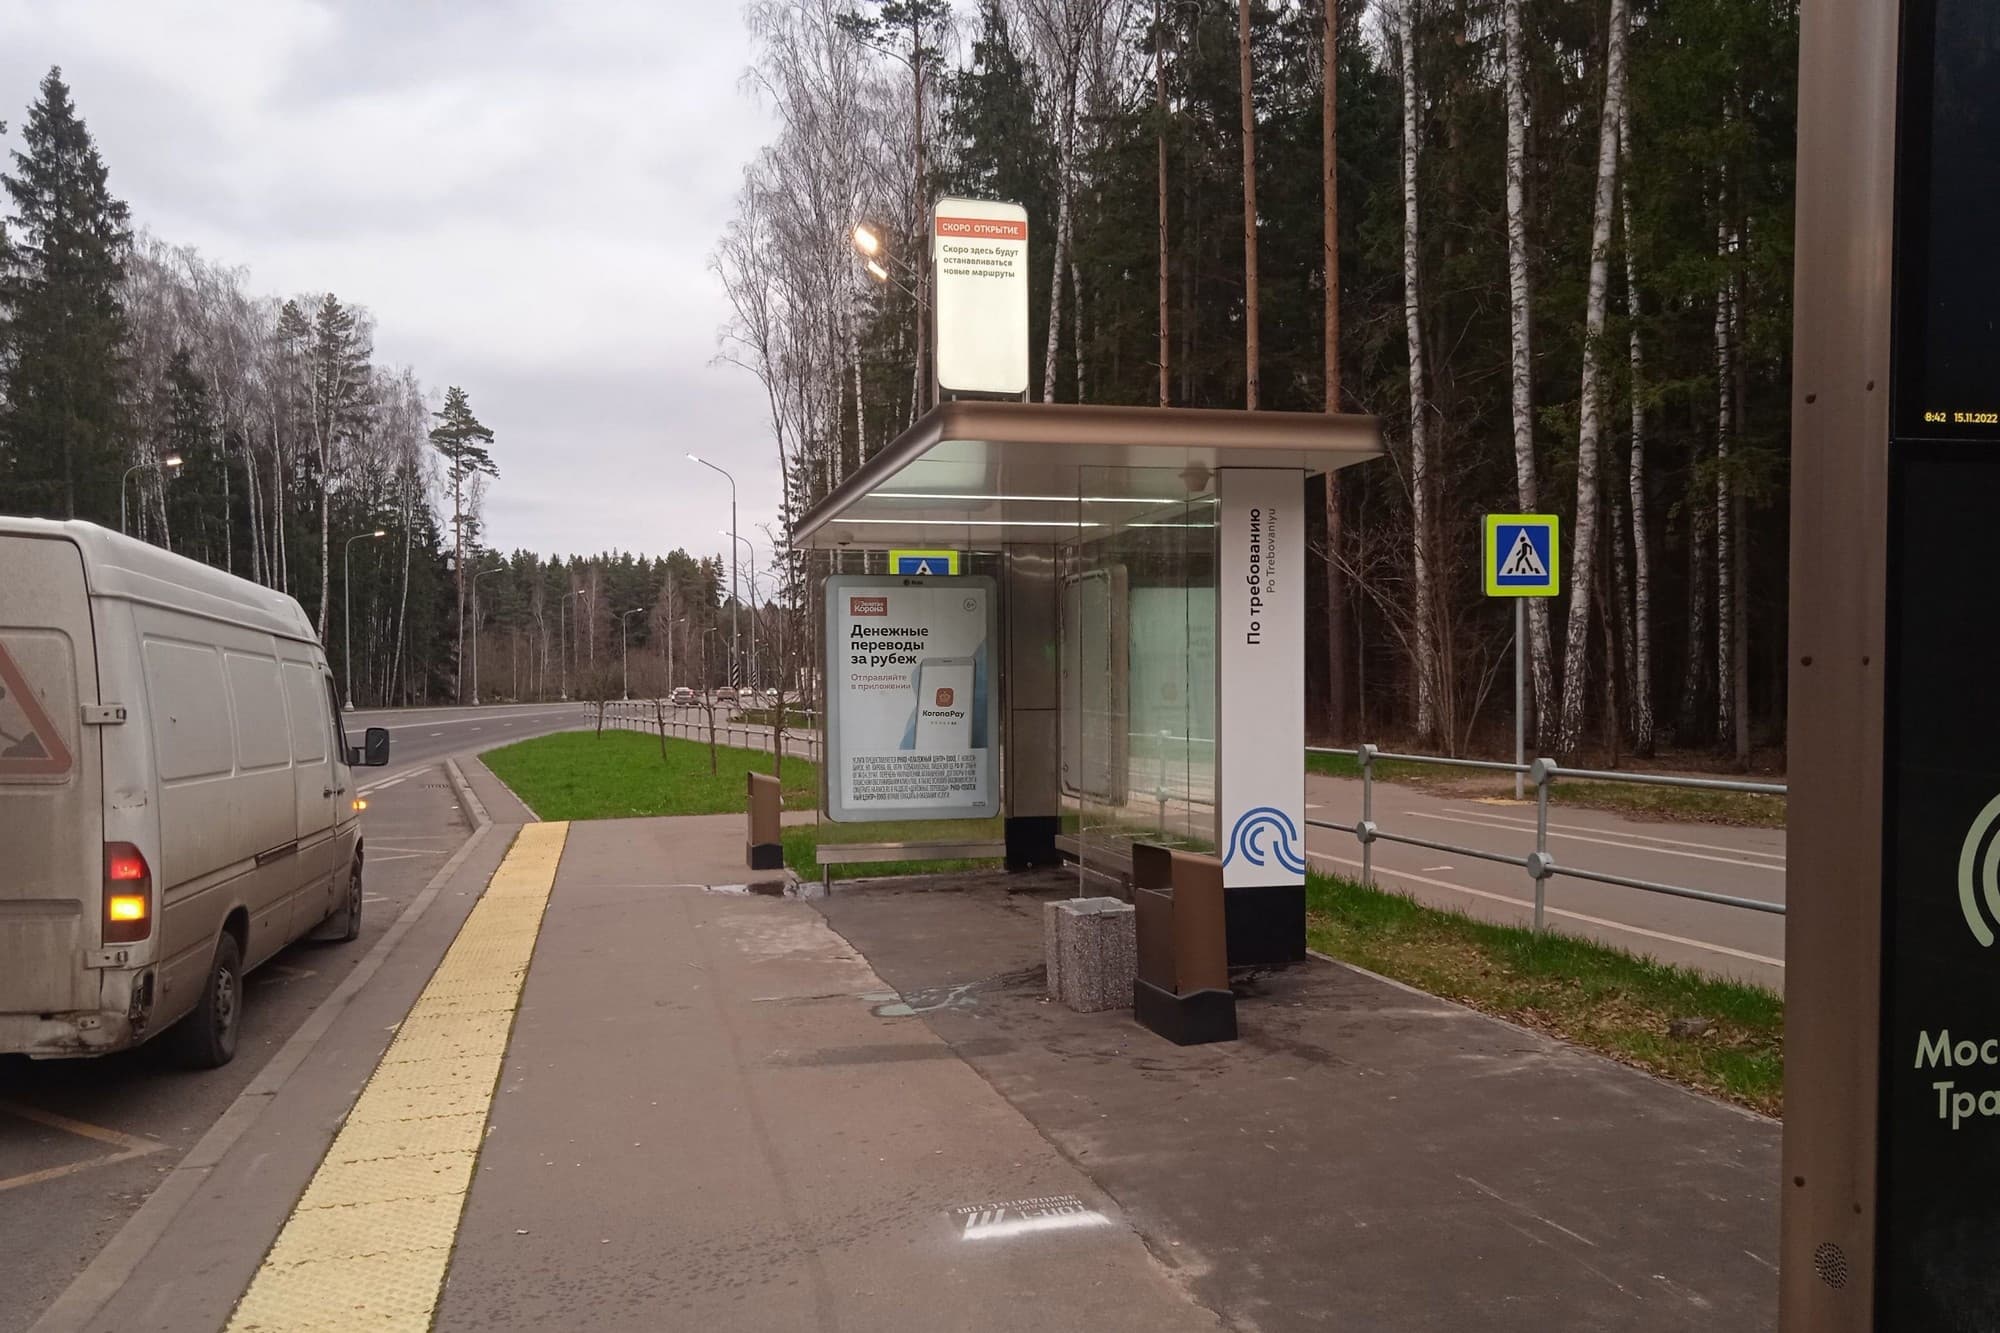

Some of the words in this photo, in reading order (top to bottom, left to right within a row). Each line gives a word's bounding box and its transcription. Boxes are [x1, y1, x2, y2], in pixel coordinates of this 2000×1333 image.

[942, 223, 971, 232] СКОРО
[974, 224, 1019, 235] ОТКРЫТИЕ
[943, 244, 969, 254] Скоро
[970, 247, 994, 255] здесь
[995, 247, 1019, 257] будут
[943, 257, 1013, 266] останавливаться
[943, 267, 970, 275] новые
[972, 269, 1015, 278] маршруты
[1925, 412, 1946, 422] 8:42
[1954, 412, 1998, 423] 15.11.2022
[1266, 508, 1277, 577] Trebovaniyu
[1246, 508, 1264, 616] требованию
[1266, 579, 1276, 593] Po
[854, 604, 884, 613] Корона
[851, 624, 929, 638] Денежные
[1247, 621, 1261, 645] По
[851, 640, 925, 653] переводы
[851, 655, 867, 664] за
[871, 653, 917, 667] рубеж
[851, 673, 907, 683] Отправляйте
[857, 683, 911, 691] приложении
[922, 710, 965, 719] KoronaPay
[1914, 1029, 1999, 1069] Мос
[1932, 1081, 2000, 1130] Тра
